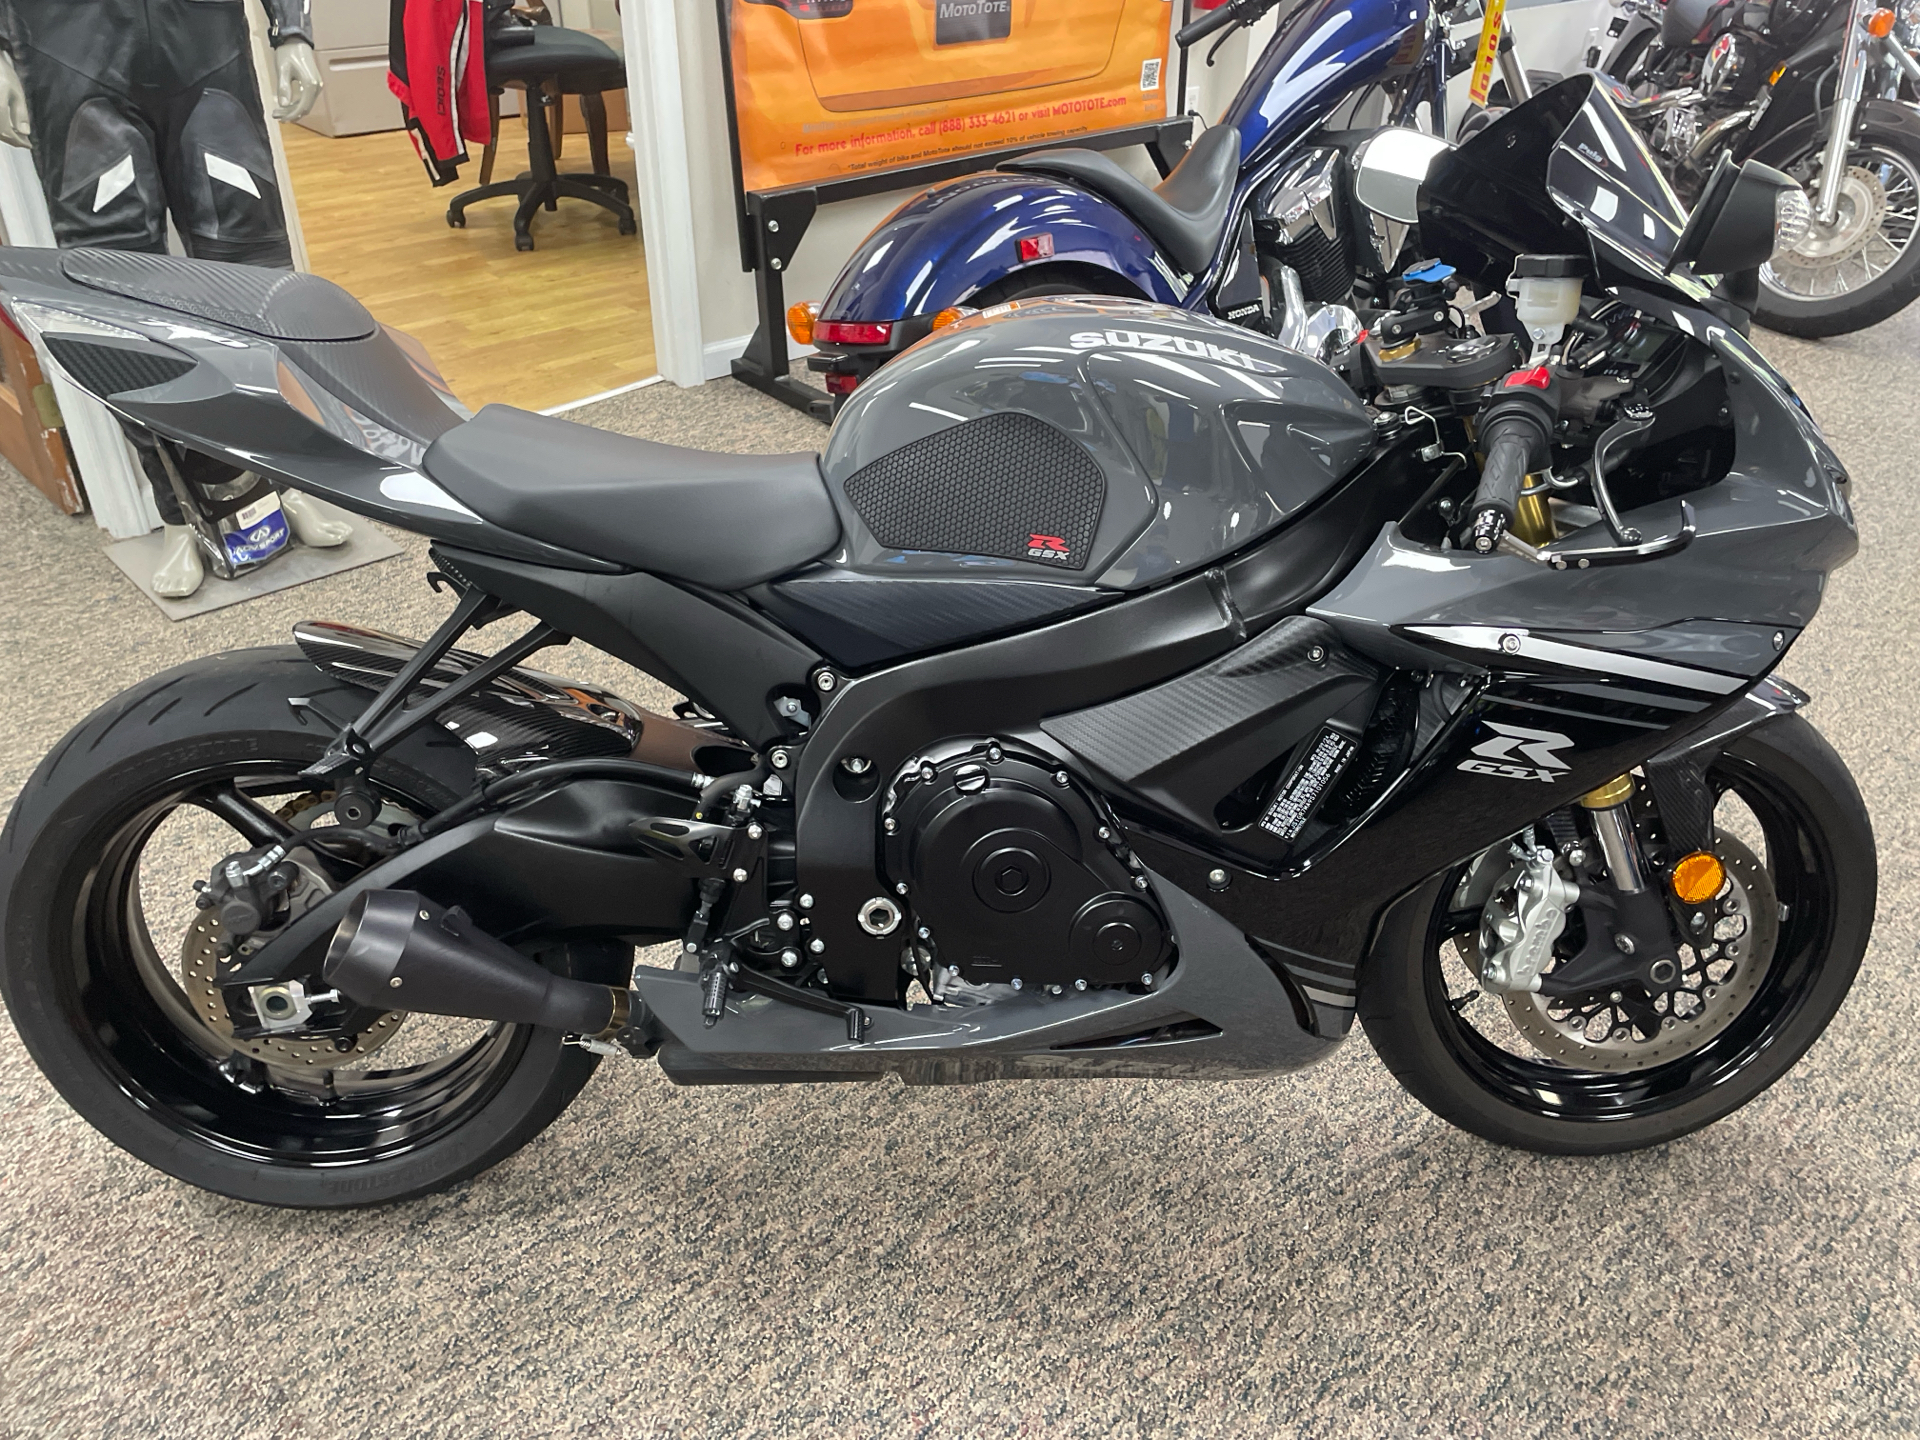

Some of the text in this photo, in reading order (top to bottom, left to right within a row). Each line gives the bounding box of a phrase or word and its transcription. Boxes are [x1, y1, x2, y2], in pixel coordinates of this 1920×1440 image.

[1480, 11, 1502, 91] SOLD
[794, 141, 814, 156] For
[817, 138, 847, 152] more
[850, 127, 916, 149] information,
[917, 121, 936, 136] call
[939, 117, 966, 136] (888)
[968, 110, 1016, 130] 333-4621
[1017, 111, 1029, 121] or
[1030, 105, 1050, 119] visit
[1052, 96, 1127, 116] MOTOTOTE.com
[867, 158, 888, 168] weight
[951, 143, 972, 151] should
[984, 138, 1004, 146] exceed
[1026, 131, 1045, 140] vehicle
[1046, 129, 1065, 138] towing
[1578, 143, 1604, 163] Puig
[1227, 304, 1260, 320] HONDA
[1069, 329, 1256, 370] SUZUKI
[1028, 533, 1070, 552] R
[1028, 548, 1069, 560] GSX
[1471, 720, 1575, 770] R
[1457, 759, 1570, 783] GSX
[1516, 908, 1560, 976] brembo
